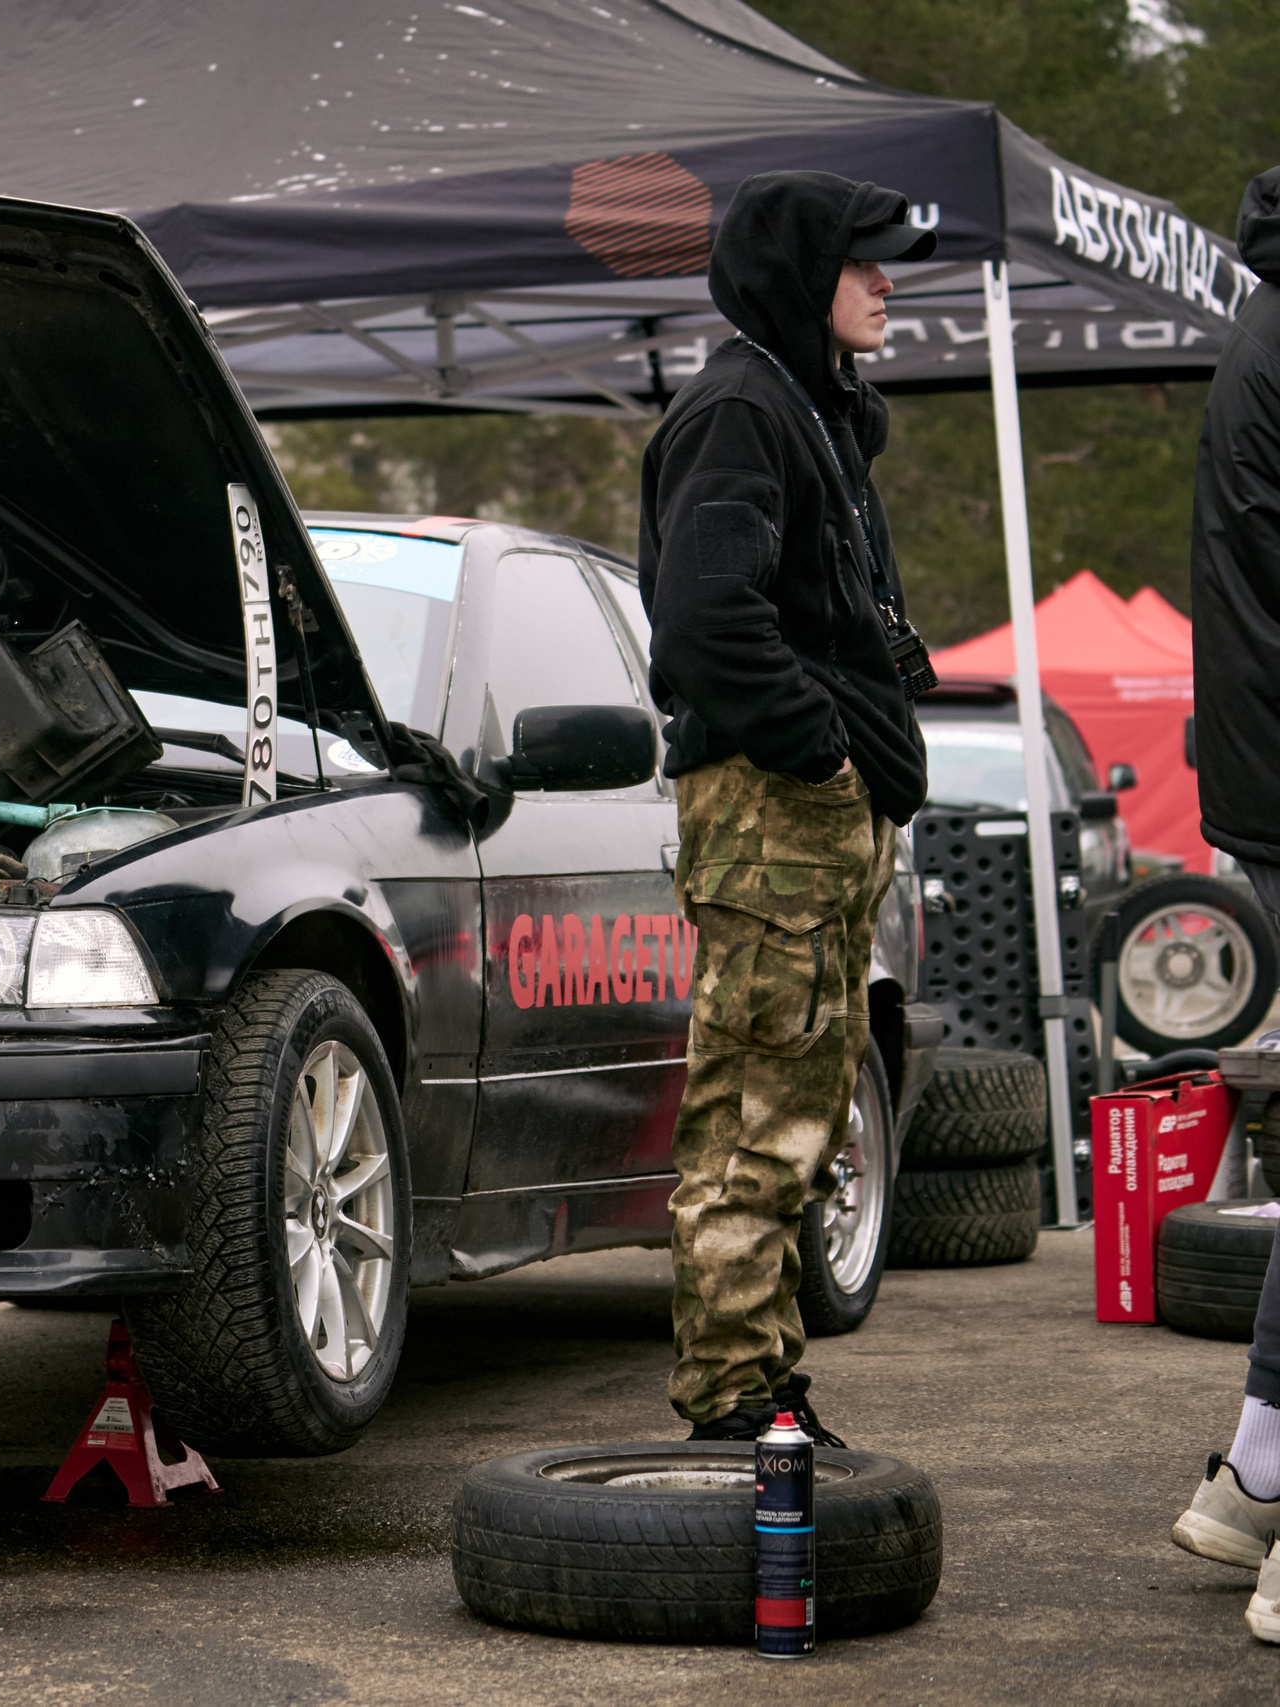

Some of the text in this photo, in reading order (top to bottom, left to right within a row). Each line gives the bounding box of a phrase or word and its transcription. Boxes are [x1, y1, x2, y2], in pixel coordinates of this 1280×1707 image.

[818, 420, 830, 442] Driving
[827, 441, 844, 476] Experience
[235, 504, 261, 599] 790
[252, 516, 264, 563] RUS
[857, 517, 868, 540] Driving
[863, 539, 879, 574] Experience
[508, 913, 699, 1010] GARAGETU
[1108, 1107, 1123, 1175] Радиатор
[1123, 1107, 1138, 1192] охлаждения
